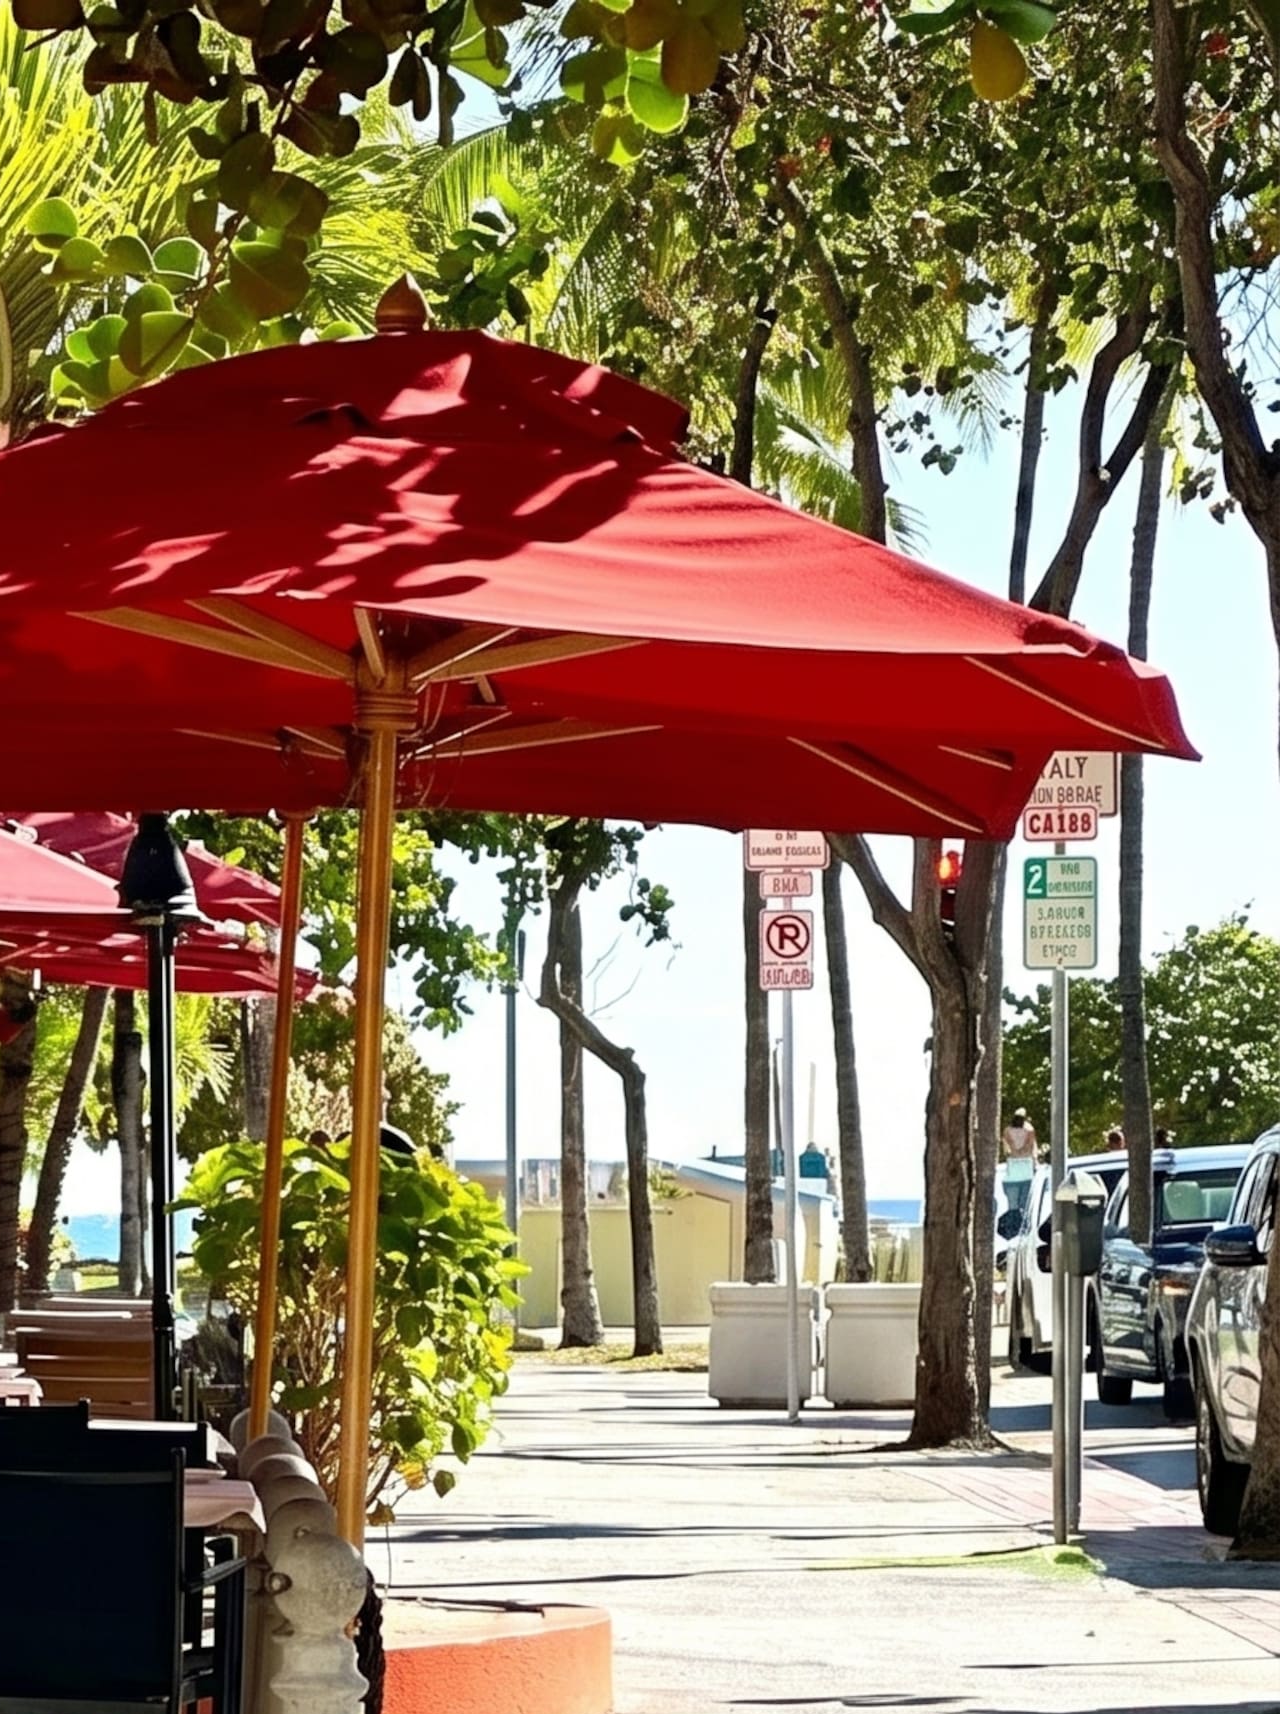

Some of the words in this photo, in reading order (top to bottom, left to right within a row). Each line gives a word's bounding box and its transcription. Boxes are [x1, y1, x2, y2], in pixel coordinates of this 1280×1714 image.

[1041, 757, 1088, 779] ALY
[1028, 812, 1092, 834] CA188
[1027, 864, 1043, 894] 2
